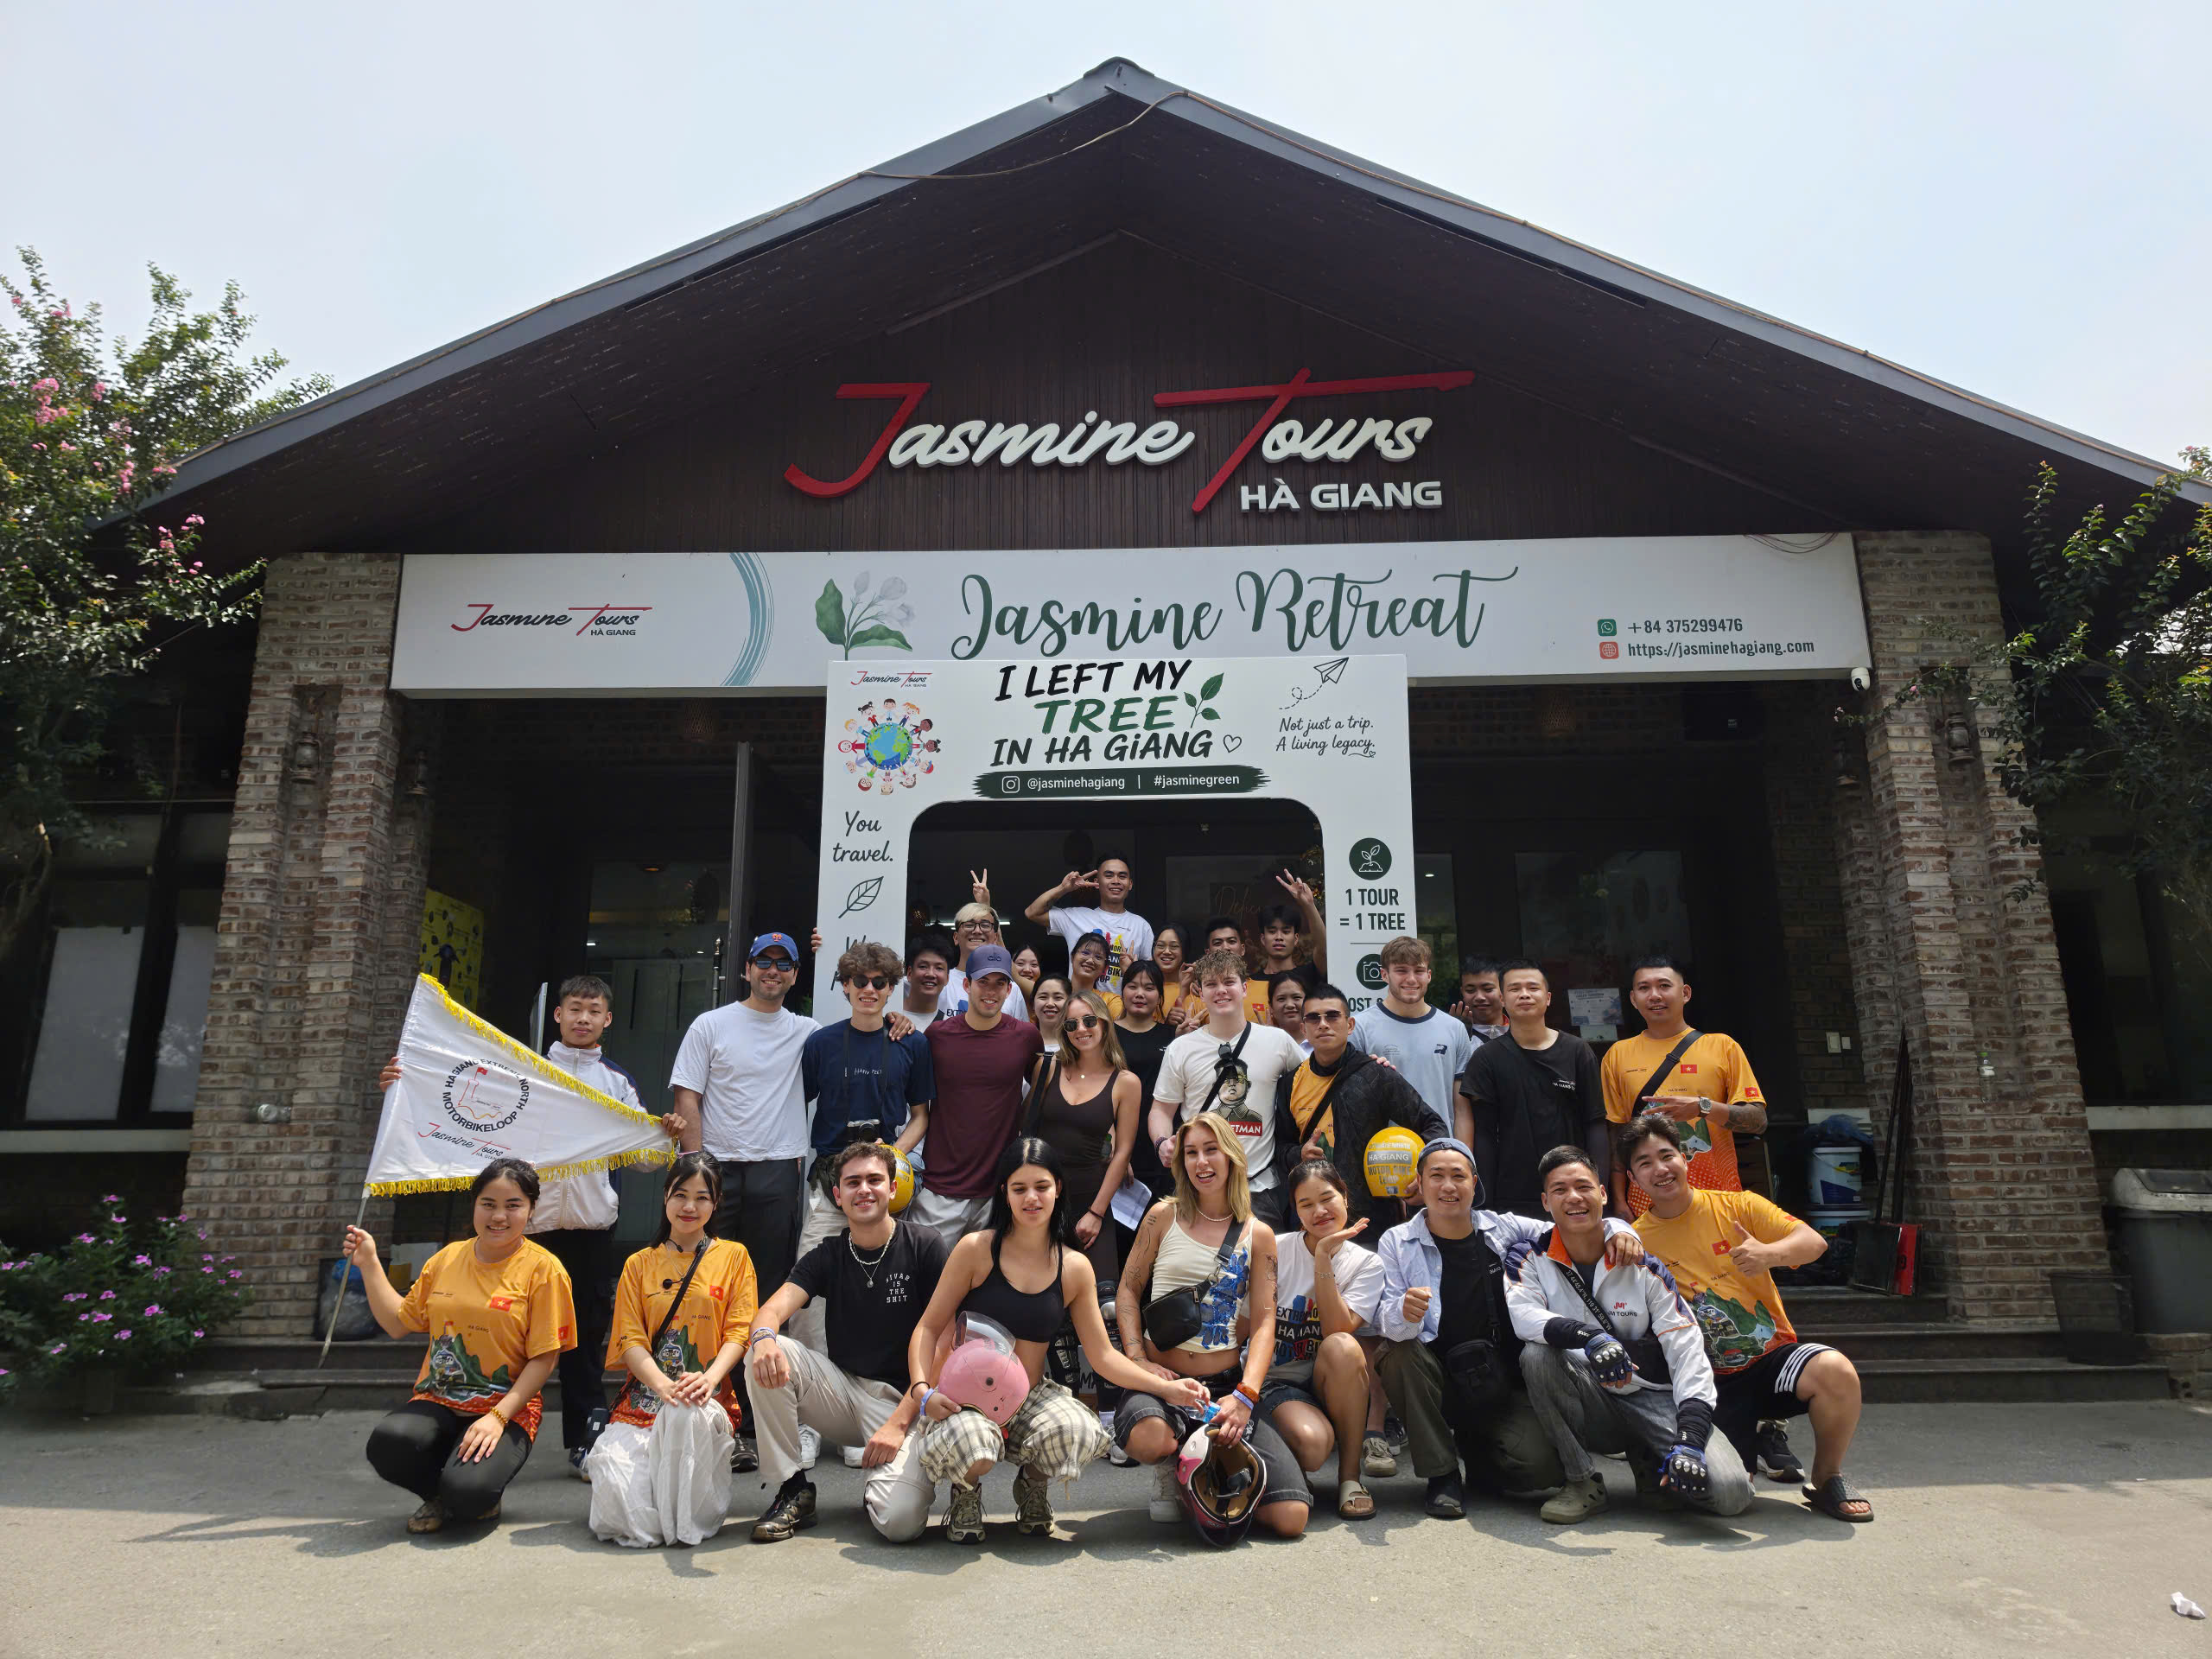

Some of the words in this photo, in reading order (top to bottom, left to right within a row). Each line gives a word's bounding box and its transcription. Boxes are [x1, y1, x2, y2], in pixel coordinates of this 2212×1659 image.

[784, 383, 1195, 499] Jasmine
[1154, 367, 1475, 512] Tours
[1241, 477, 1300, 512] HÀ
[1311, 481, 1443, 512] GIANG
[450, 603, 573, 632] Jasmine
[568, 603, 653, 636] Tours
[950, 575, 1223, 661] Jasmine
[1236, 566, 1519, 652] Retreat
[1666, 618, 1744, 633] 375299476
[1628, 640, 1815, 659] https://jasminehagiang.com
[850, 671, 901, 686] Jasmine
[897, 671, 933, 688] Tours
[995, 664, 1017, 702] I
[1024, 661, 1124, 698] LEFT
[1133, 659, 1192, 691] MY
[1033, 695, 1179, 734] TREE
[1279, 716, 1304, 733] Not
[1302, 716, 1332, 737] just
[1334, 721, 1344, 729] a
[1347, 715, 1374, 734] trip.
[990, 738, 1033, 767] IN
[1045, 734, 1092, 765] HA
[1275, 736, 1287, 752] A
[1291, 735, 1328, 756] living
[1332, 734, 1376, 755] legacy.
[1027, 777, 1126, 791] @jasminehagiang
[1154, 774, 1240, 788] #jasminegreen
[845, 810, 882, 837] You
[832, 840, 893, 862] travel.
[1345, 888, 1352, 906] 1
[1358, 888, 1400, 906] TOUR
[1355, 913, 1363, 931] 1
[1368, 912, 1406, 931] TREE
[1348, 997, 1371, 1012] OST
[516, 1078, 530, 1110] NORTH
[417, 1122, 475, 1148] Jasmine
[471, 1137, 512, 1156] Tours
[1230, 1124, 1261, 1134] ETMAN
[1278, 1325, 1295, 1339] HA
